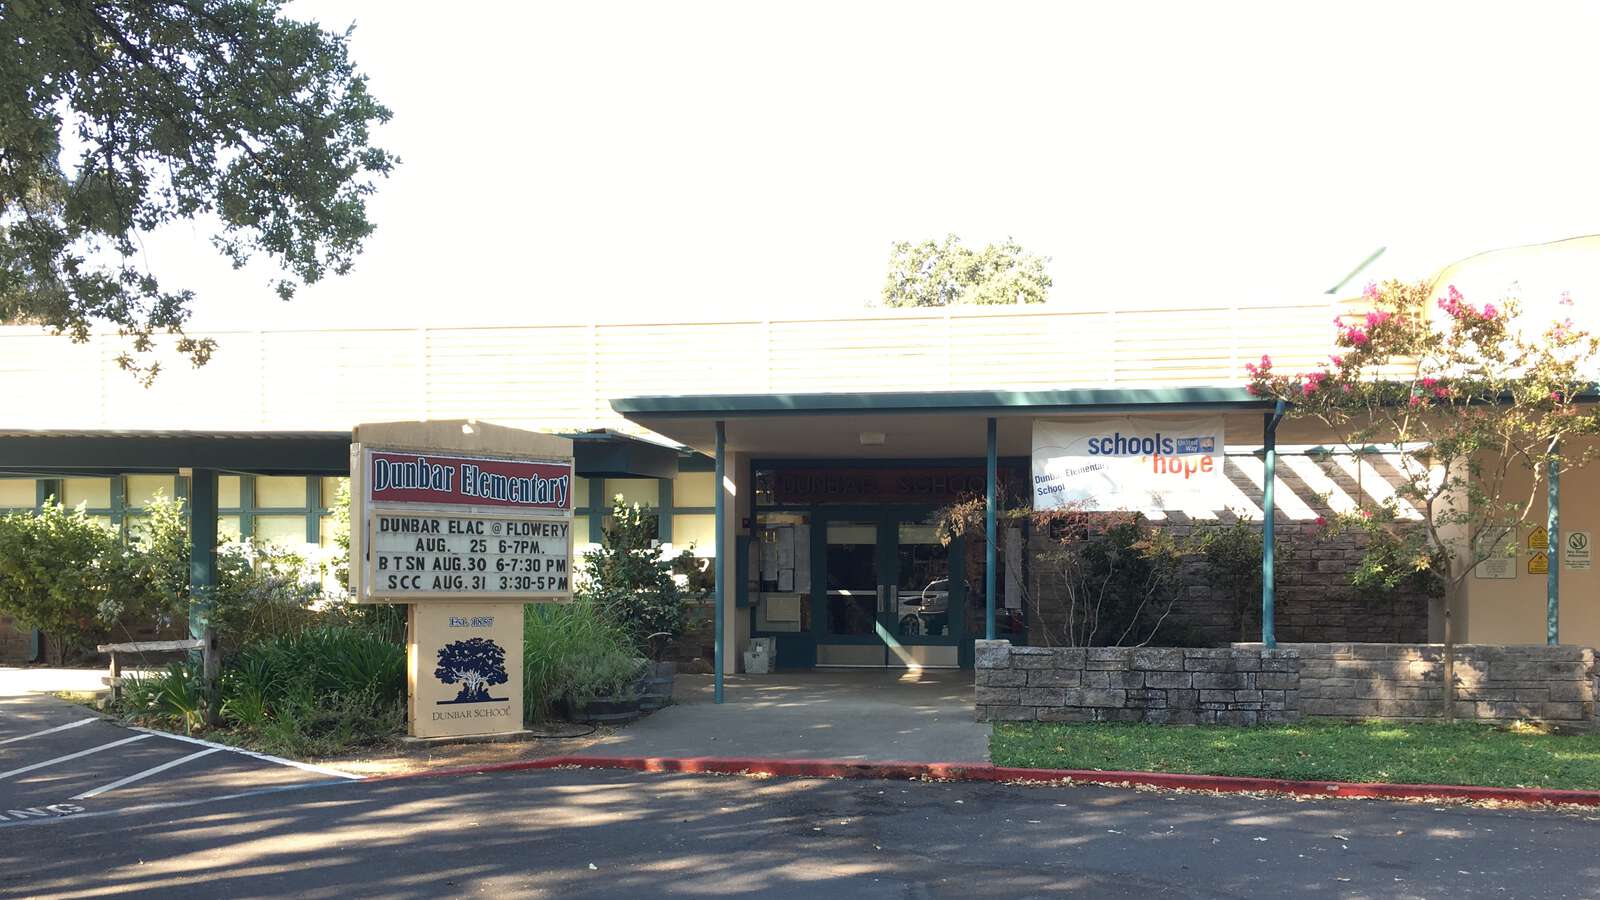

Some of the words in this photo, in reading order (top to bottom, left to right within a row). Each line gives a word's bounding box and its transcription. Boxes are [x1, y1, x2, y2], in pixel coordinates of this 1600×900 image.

[1088, 432, 1174, 455] schools
[1153, 452, 1214, 479] hope
[374, 457, 455, 492] Dunbar
[460, 463, 569, 507] Elementary
[1036, 482, 1066, 497] School
[380, 518, 440, 534] DUNBAR
[448, 520, 485, 535] ELAC
[491, 522, 502, 535] @
[506, 522, 568, 538] FLOWERY
[415, 538, 451, 553] AUG.
[469, 539, 487, 553] 25
[496, 559, 541, 572] 6-7:30
[546, 559, 567, 573] PM
[387, 575, 421, 590] SCC
[431, 711, 473, 721] DUNBAR
[474, 706, 512, 718] SCHOOL
